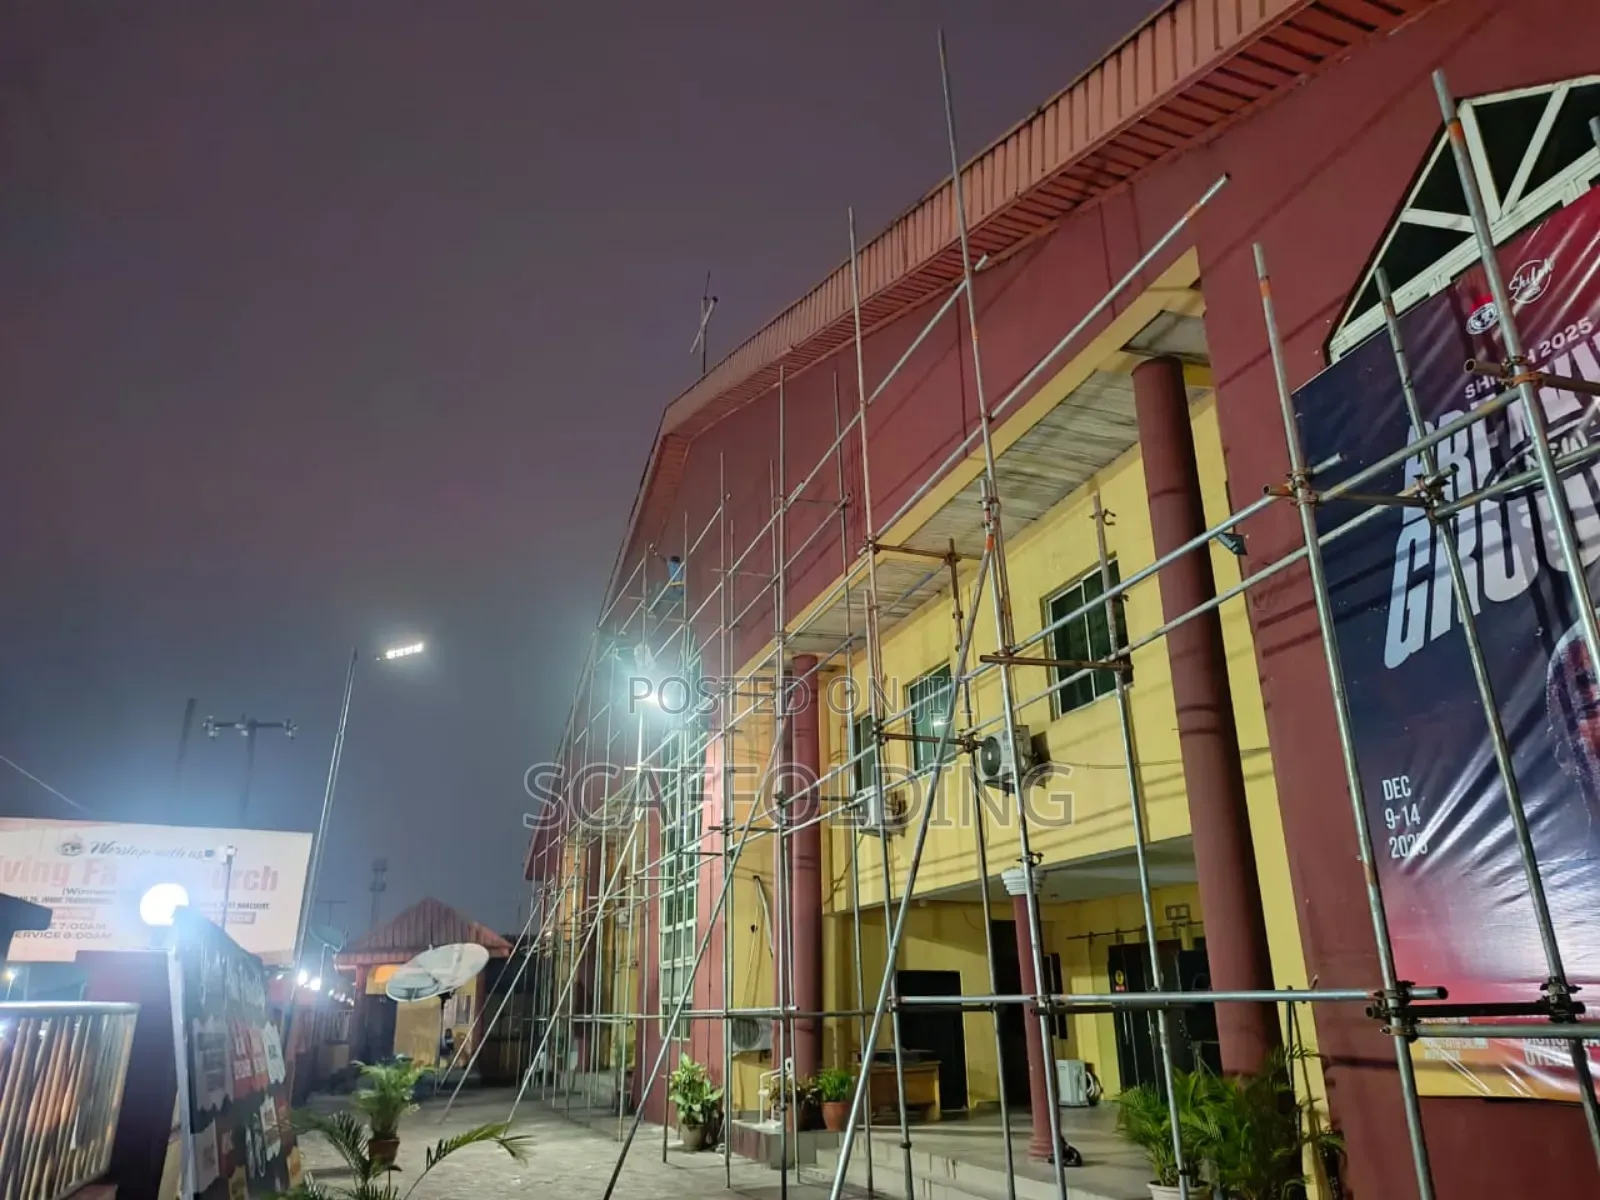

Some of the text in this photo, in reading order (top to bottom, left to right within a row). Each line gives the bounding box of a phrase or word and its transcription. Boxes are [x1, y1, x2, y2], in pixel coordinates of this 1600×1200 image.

[1539, 316, 1594, 358] 2025
[1382, 775, 1411, 801] DEC
[1384, 803, 1421, 830] 9-14
[14, 931, 61, 940] ERVICE
